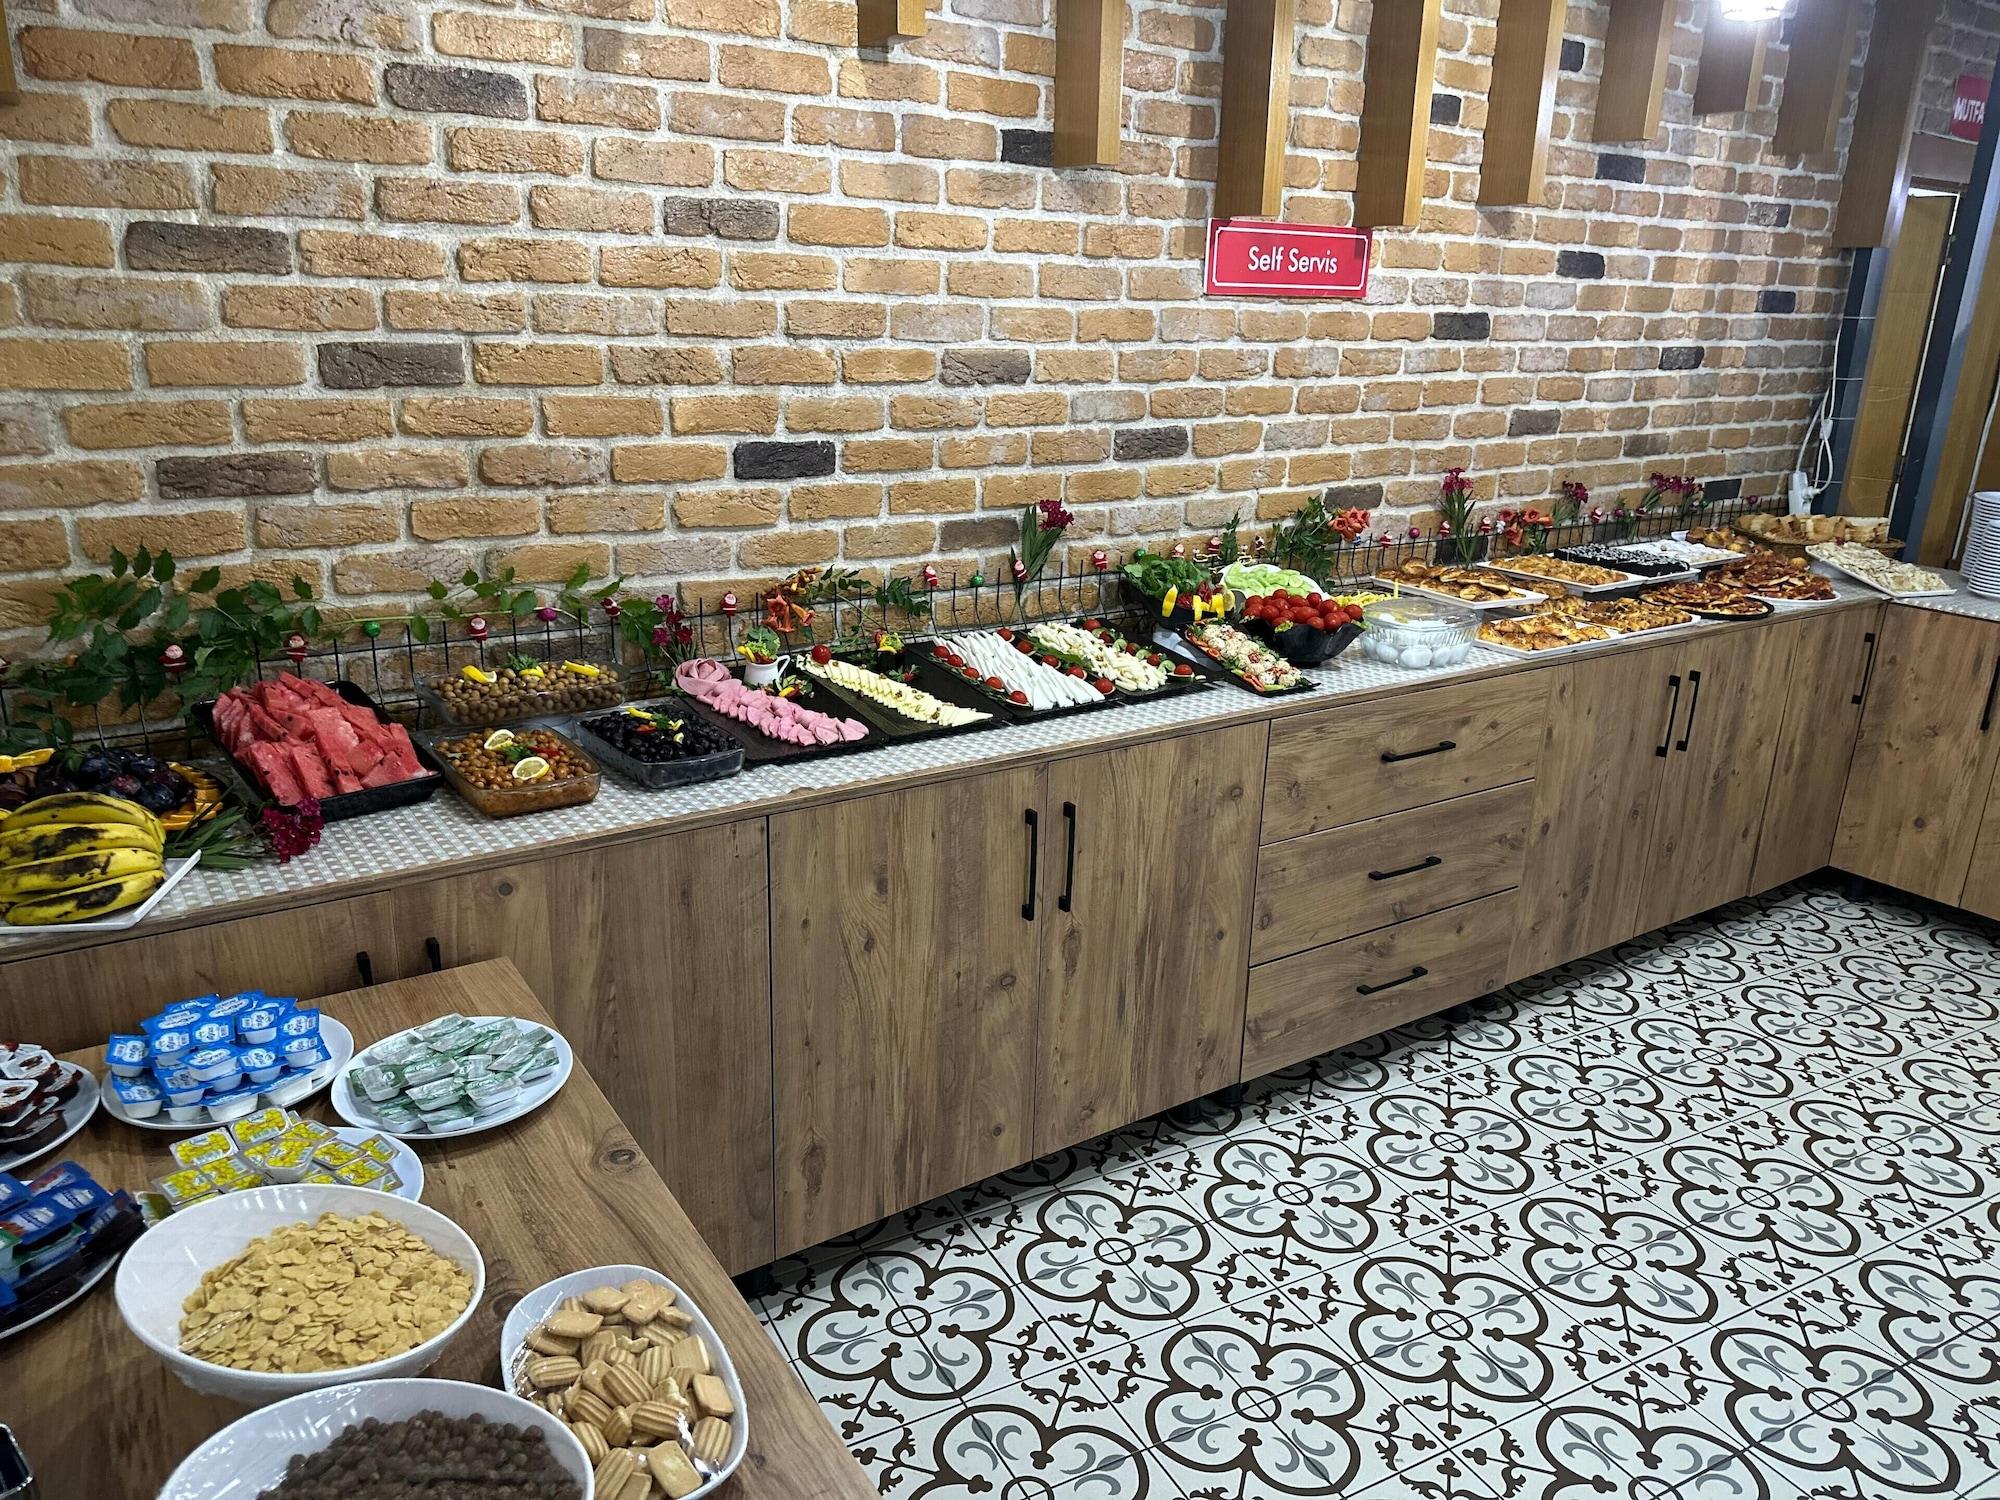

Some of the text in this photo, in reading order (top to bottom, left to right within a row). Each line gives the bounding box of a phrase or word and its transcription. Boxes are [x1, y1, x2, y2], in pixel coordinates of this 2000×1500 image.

[1953, 96, 1985, 124] MUTFA
[1247, 245, 1338, 274] Self Servis
